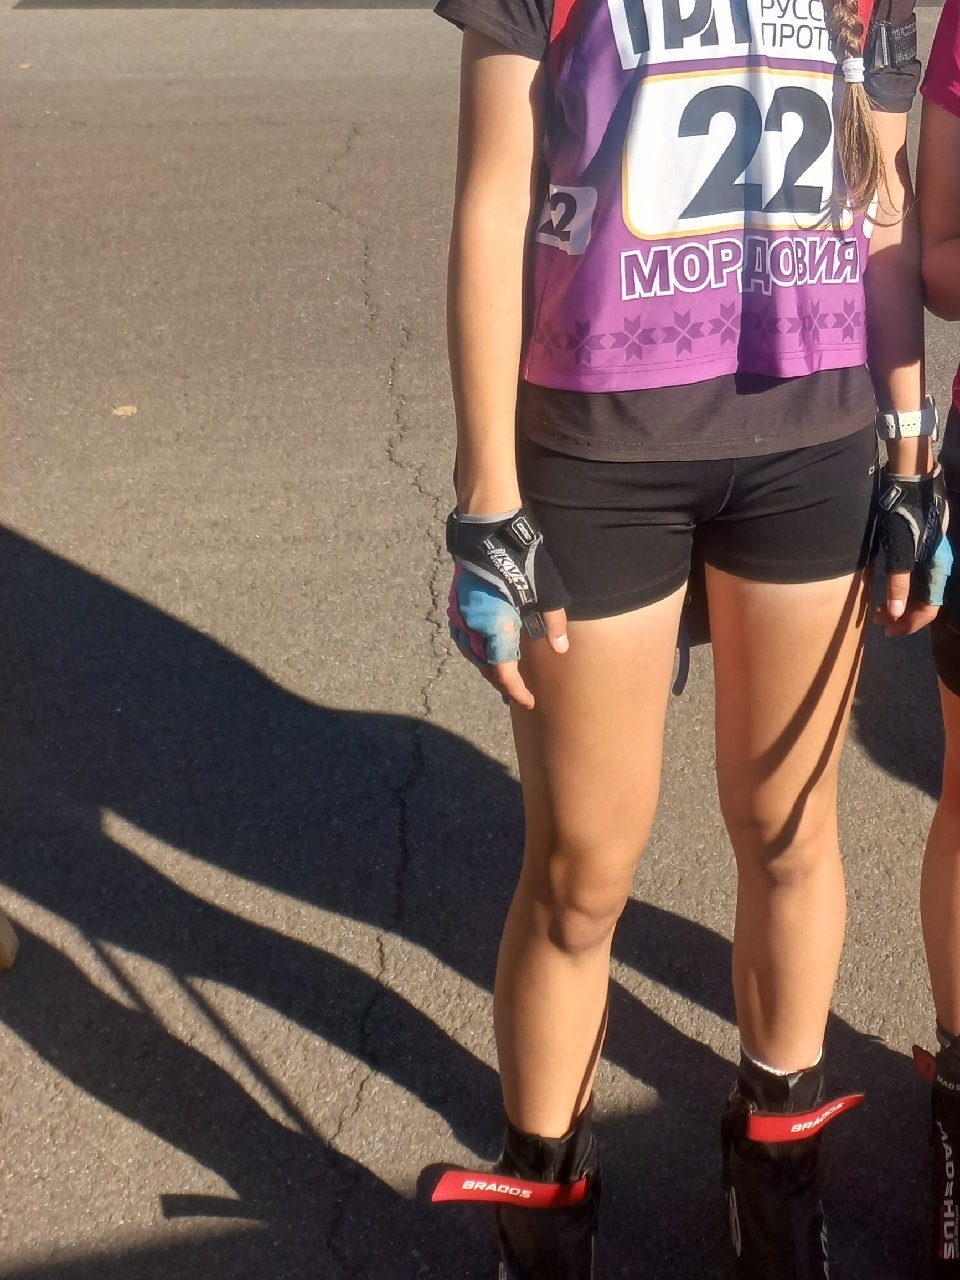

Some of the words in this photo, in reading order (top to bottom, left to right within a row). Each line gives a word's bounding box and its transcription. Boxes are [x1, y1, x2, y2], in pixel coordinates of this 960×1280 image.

[761, 22, 832, 51] ПРОТ
[677, 85, 832, 219] 22
[621, 236, 861, 301] МОРДОВИЯ
[790, 1100, 846, 1134] BRADOS
[461, 1179, 533, 1200] BRADOS
